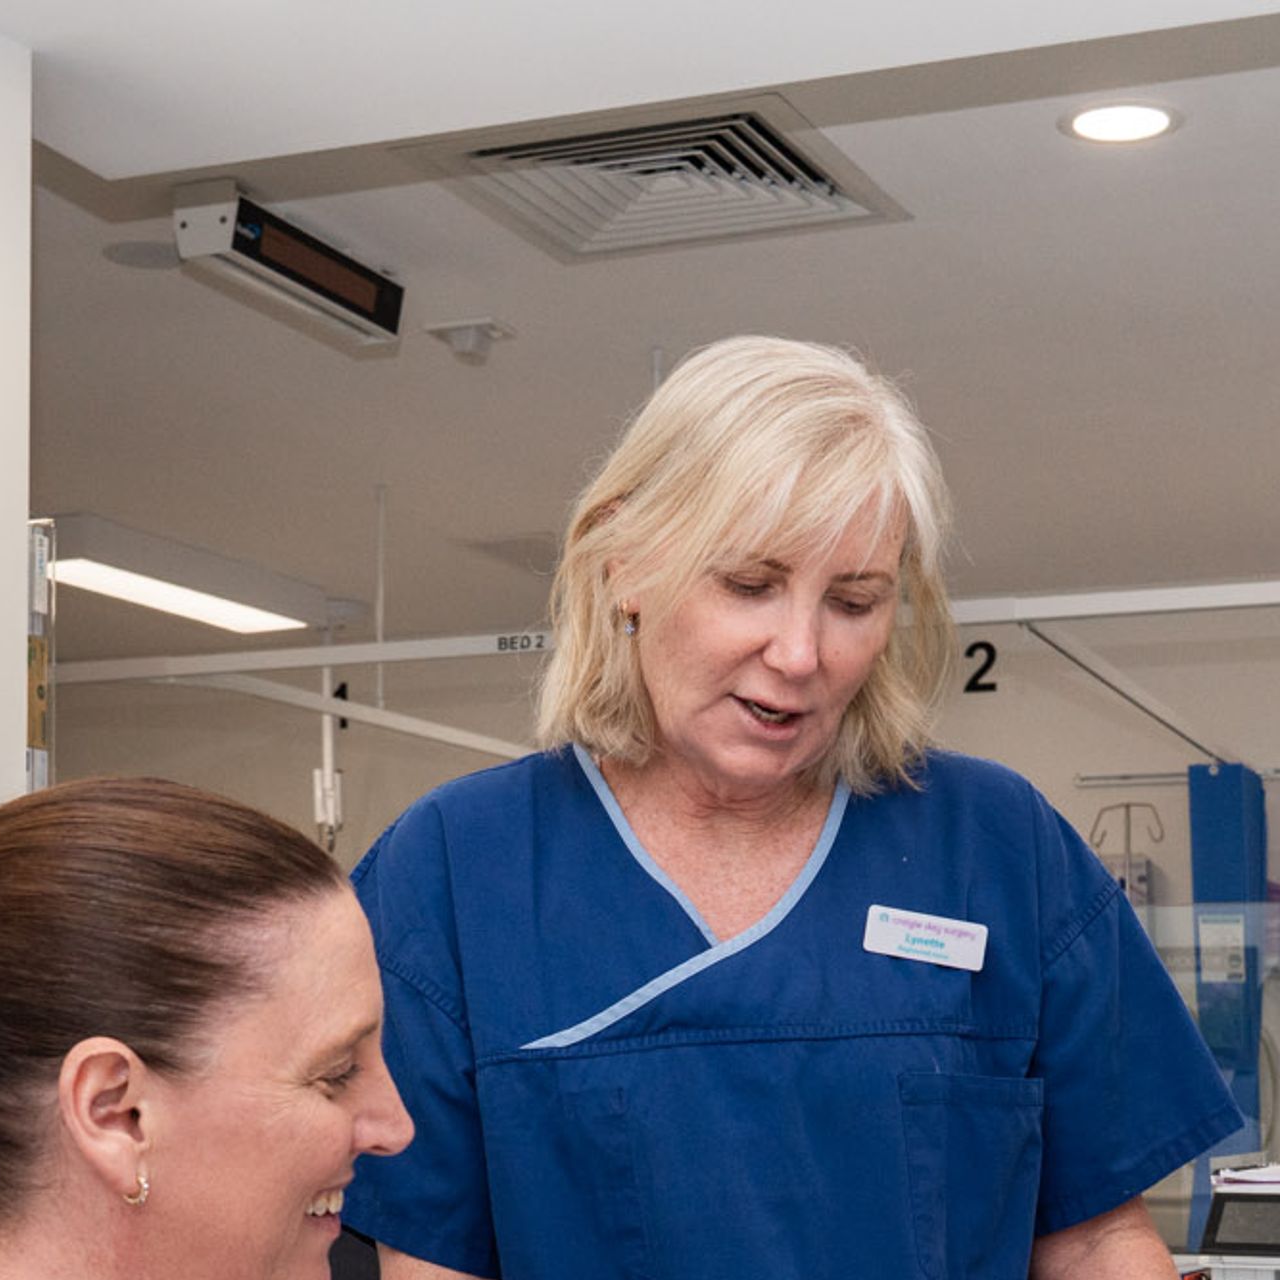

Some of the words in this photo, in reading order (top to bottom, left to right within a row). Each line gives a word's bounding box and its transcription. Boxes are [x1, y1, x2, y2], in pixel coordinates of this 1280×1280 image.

[498, 635, 531, 651] BED
[535, 634, 545, 649] 2
[963, 640, 997, 693] 2
[905, 934, 945, 948] Lynette
